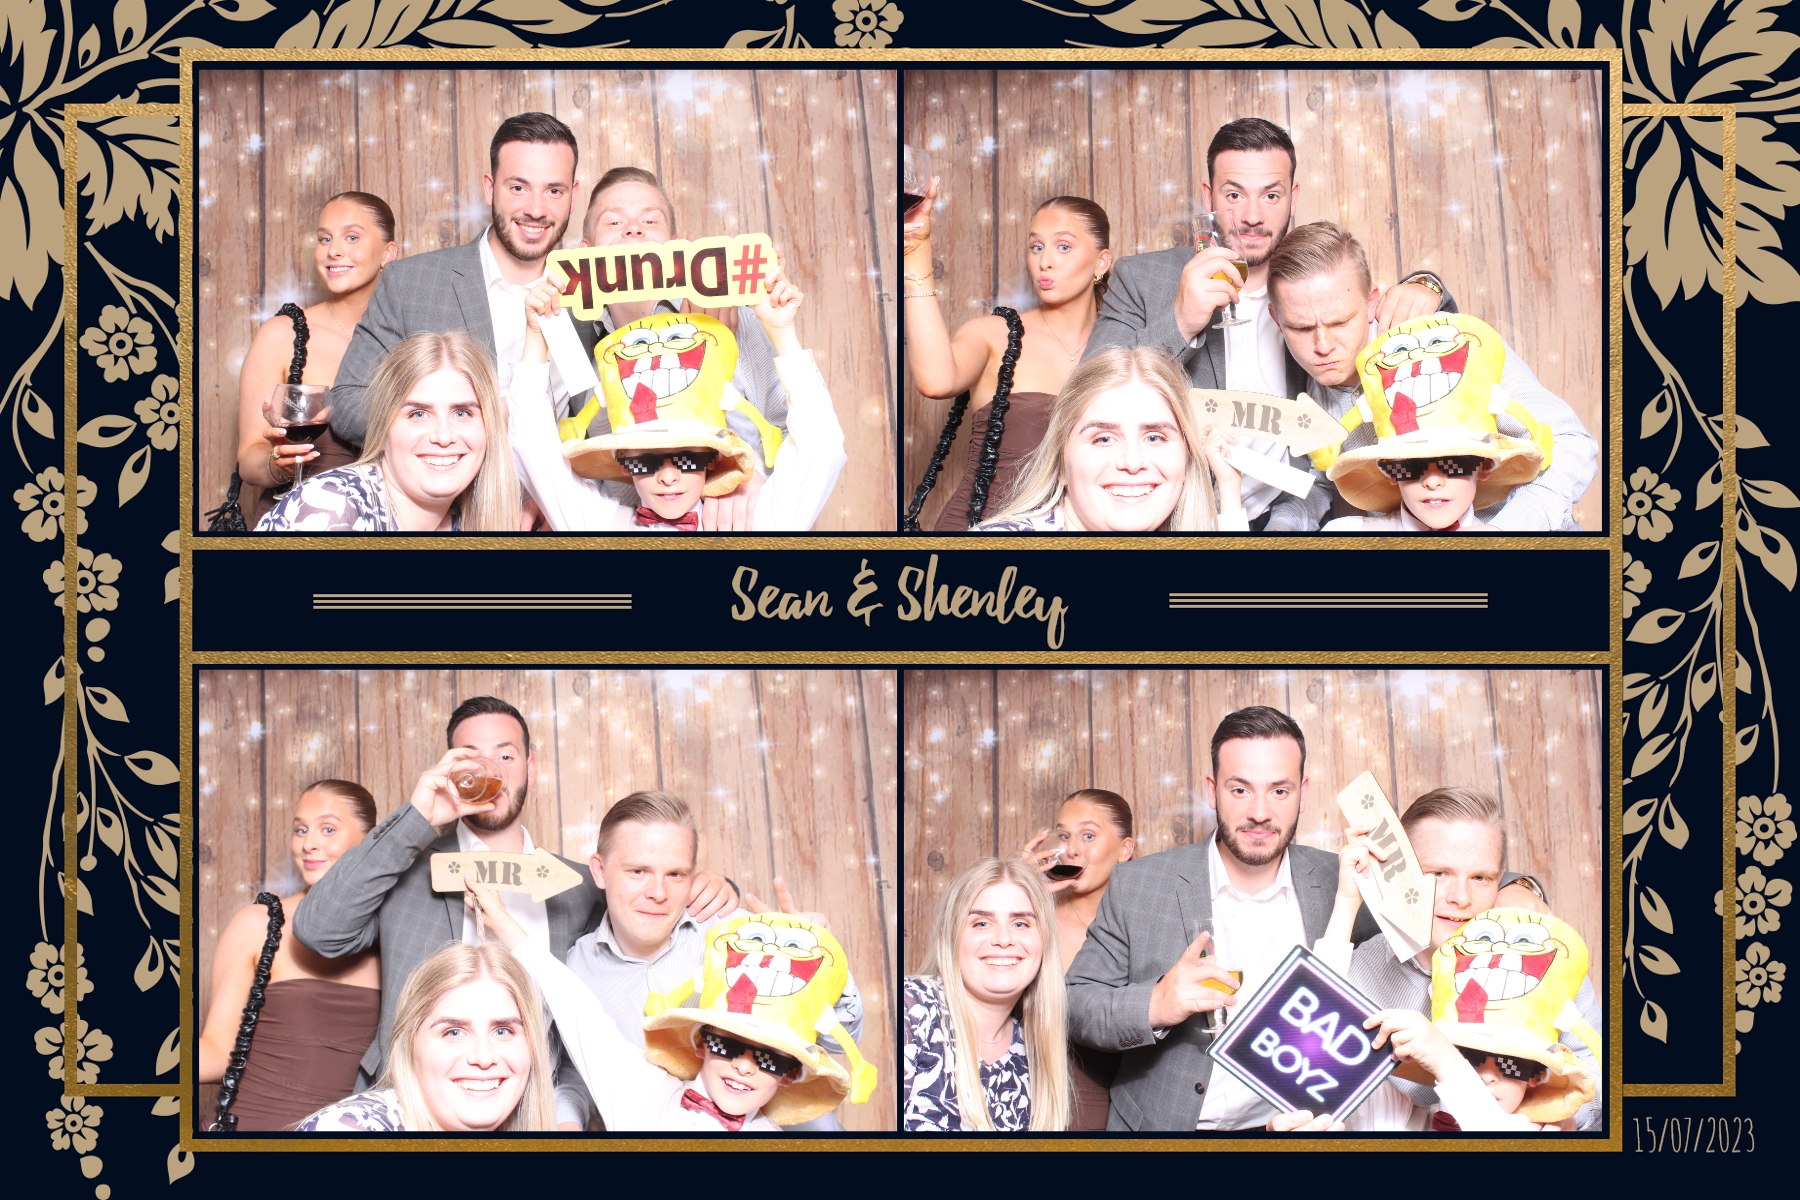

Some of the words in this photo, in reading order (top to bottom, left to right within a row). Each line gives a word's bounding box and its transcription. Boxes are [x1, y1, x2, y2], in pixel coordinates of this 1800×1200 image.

[556, 243, 768, 310] #Drunk
[1230, 400, 1282, 436] MR
[473, 860, 523, 887] MR
[1365, 816, 1407, 884] MR
[1279, 986, 1372, 1066] BAD
[1250, 1027, 1340, 1103] BOYZ
